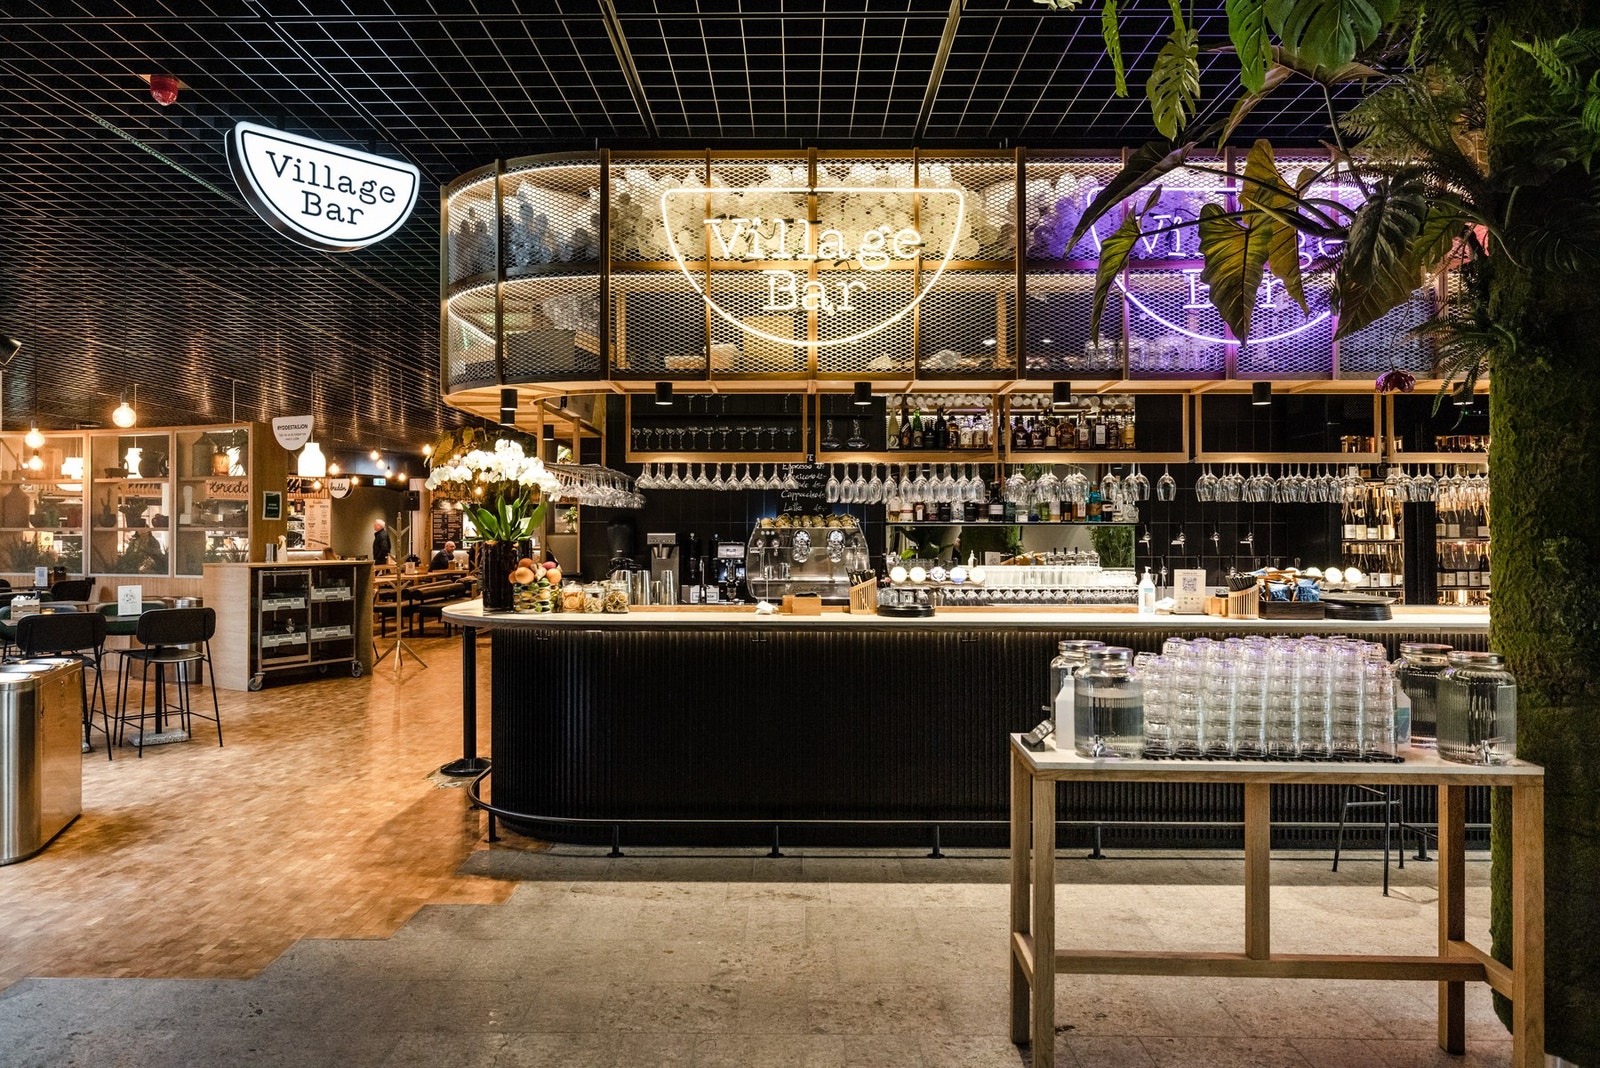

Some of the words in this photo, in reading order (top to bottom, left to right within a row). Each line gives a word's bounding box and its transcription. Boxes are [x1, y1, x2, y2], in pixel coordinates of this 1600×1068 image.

[265, 150, 396, 205] Village
[301, 190, 364, 225] Bar
[703, 217, 922, 271] Village
[763, 270, 866, 312] Bar
[1183, 268, 1284, 309] Br
